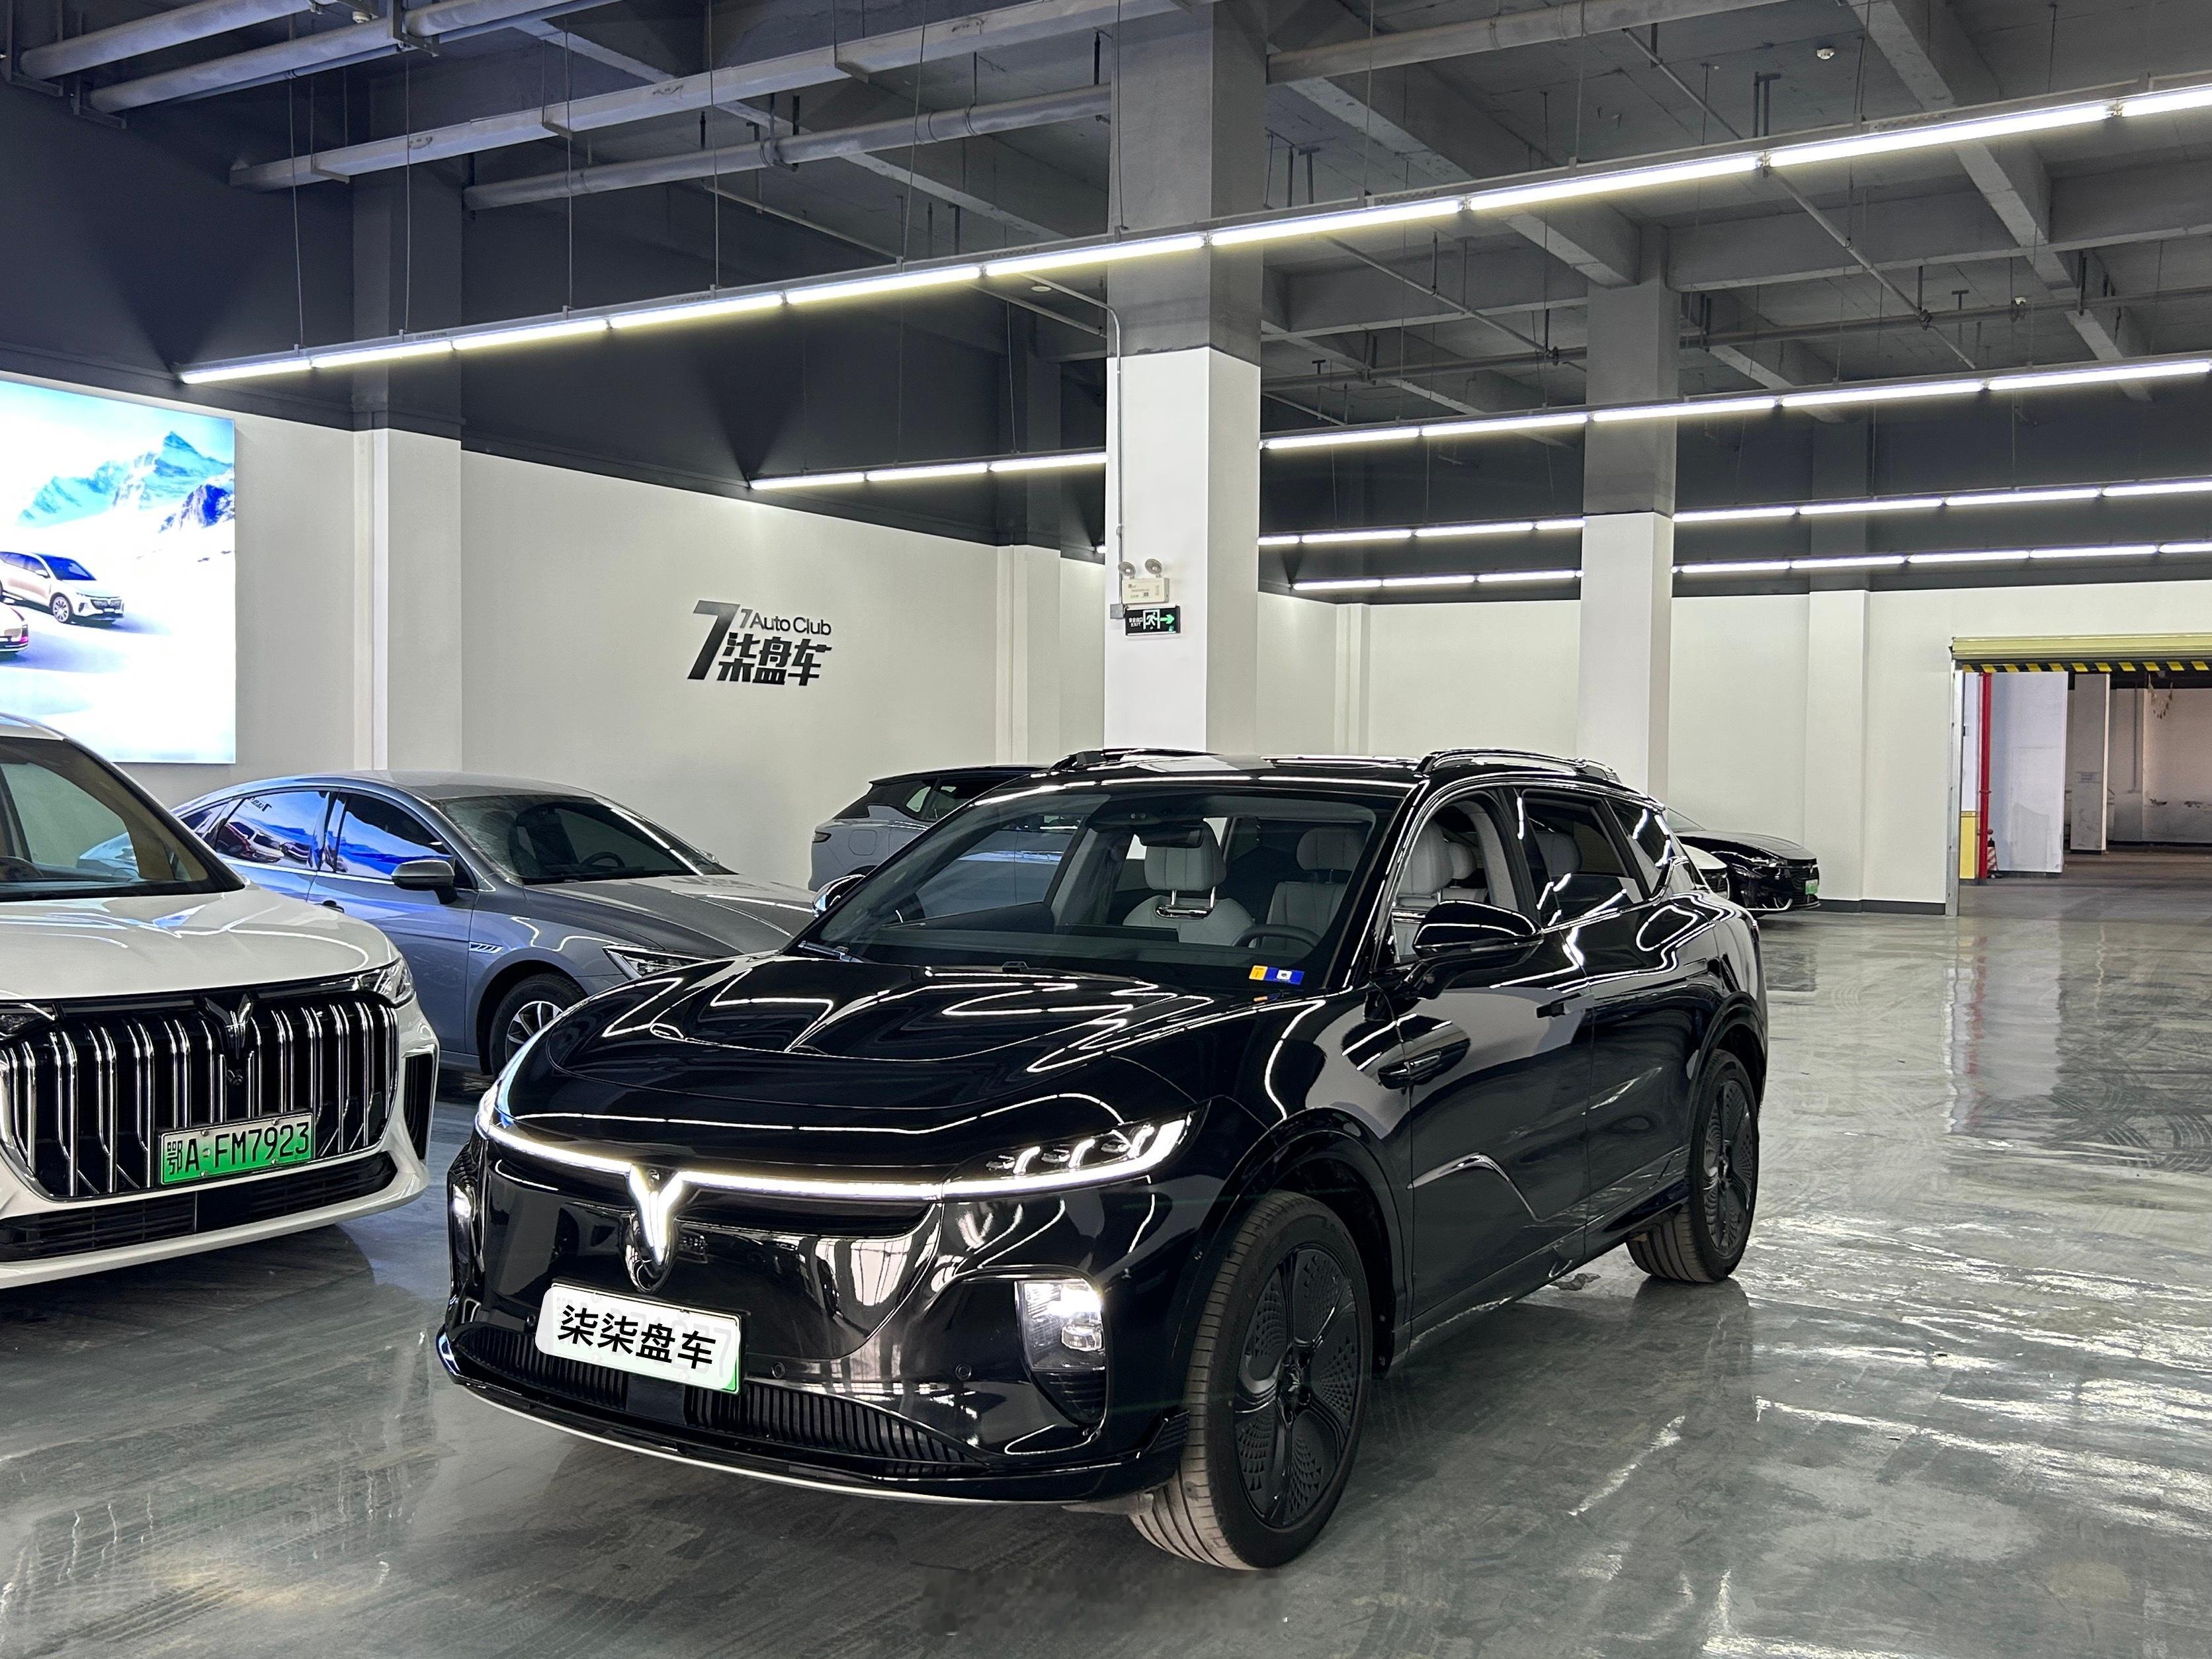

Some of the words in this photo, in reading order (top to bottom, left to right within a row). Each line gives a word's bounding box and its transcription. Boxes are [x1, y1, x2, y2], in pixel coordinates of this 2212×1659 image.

[793, 617, 832, 636] Club
[716, 632, 832, 686] 柒盘车
